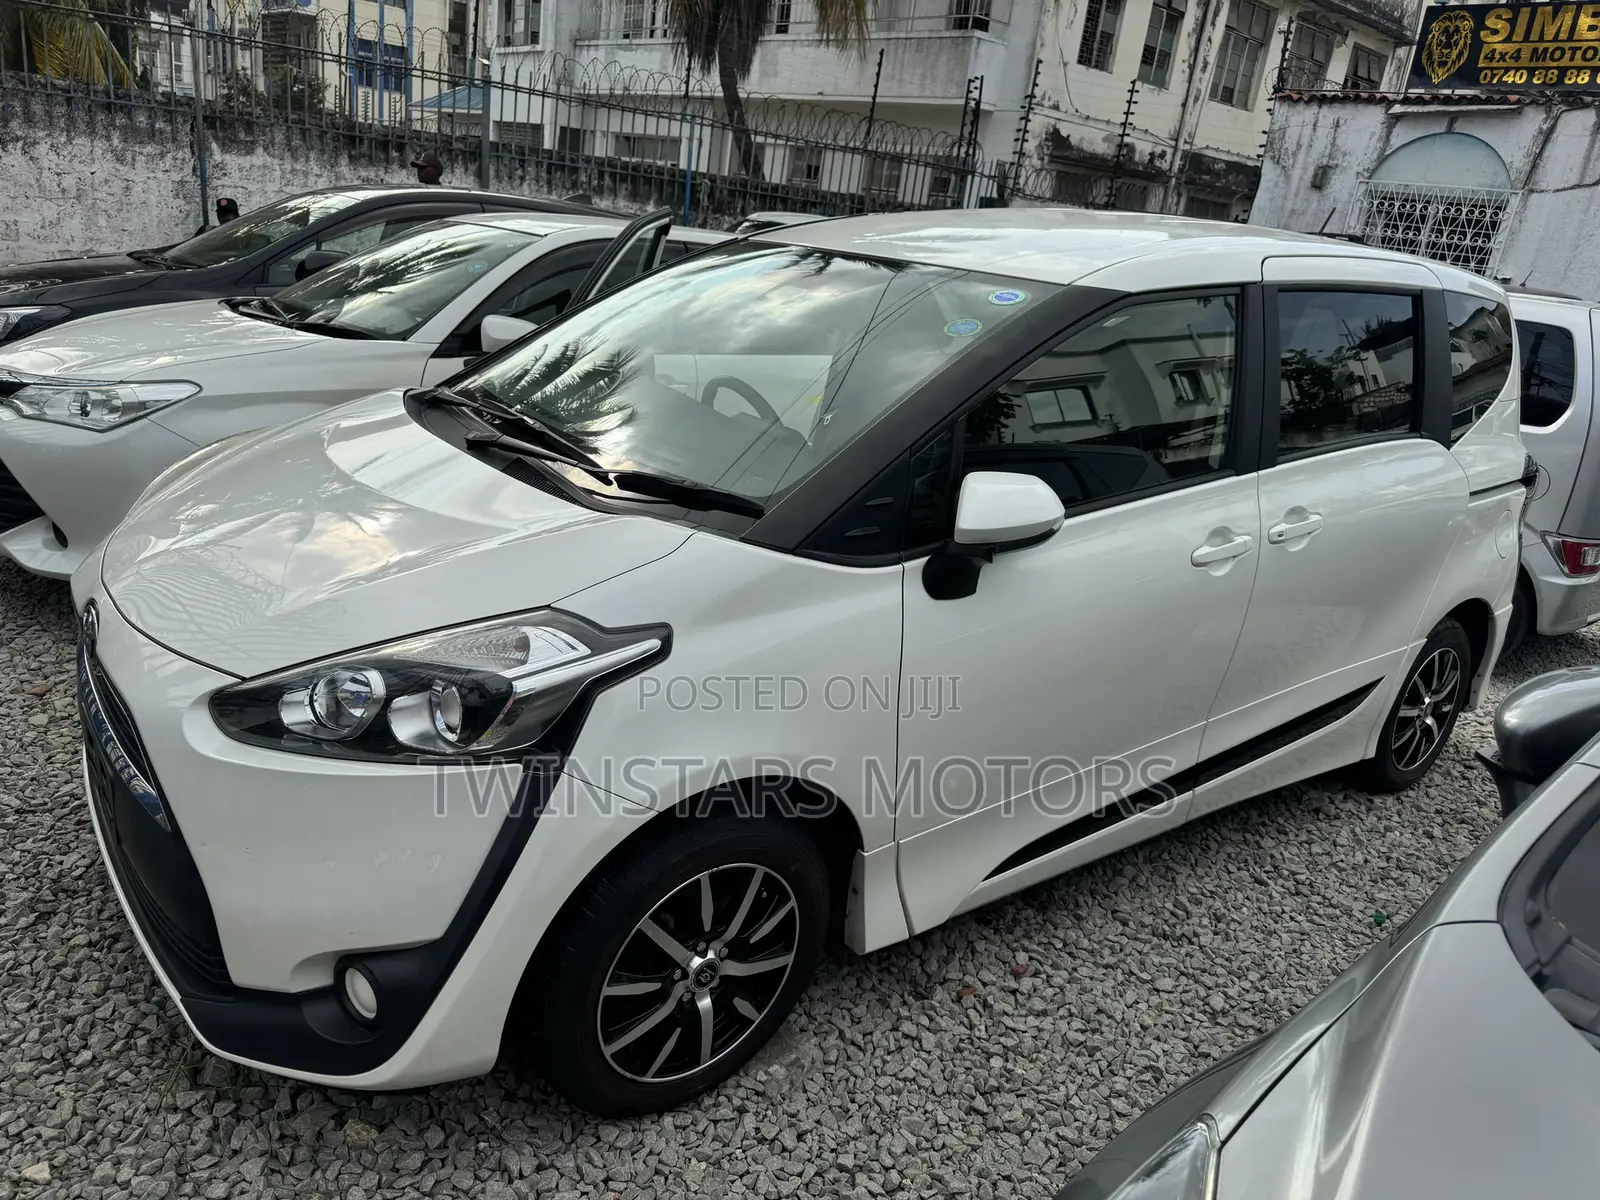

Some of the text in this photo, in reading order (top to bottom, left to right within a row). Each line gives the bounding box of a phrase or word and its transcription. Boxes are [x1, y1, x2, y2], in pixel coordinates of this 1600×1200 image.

[1483, 45, 1600, 62] 4x4 MOTO
[1479, 69, 1528, 84] 0740
[1532, 69, 1558, 84] 88
[1564, 69, 1591, 84] 88
